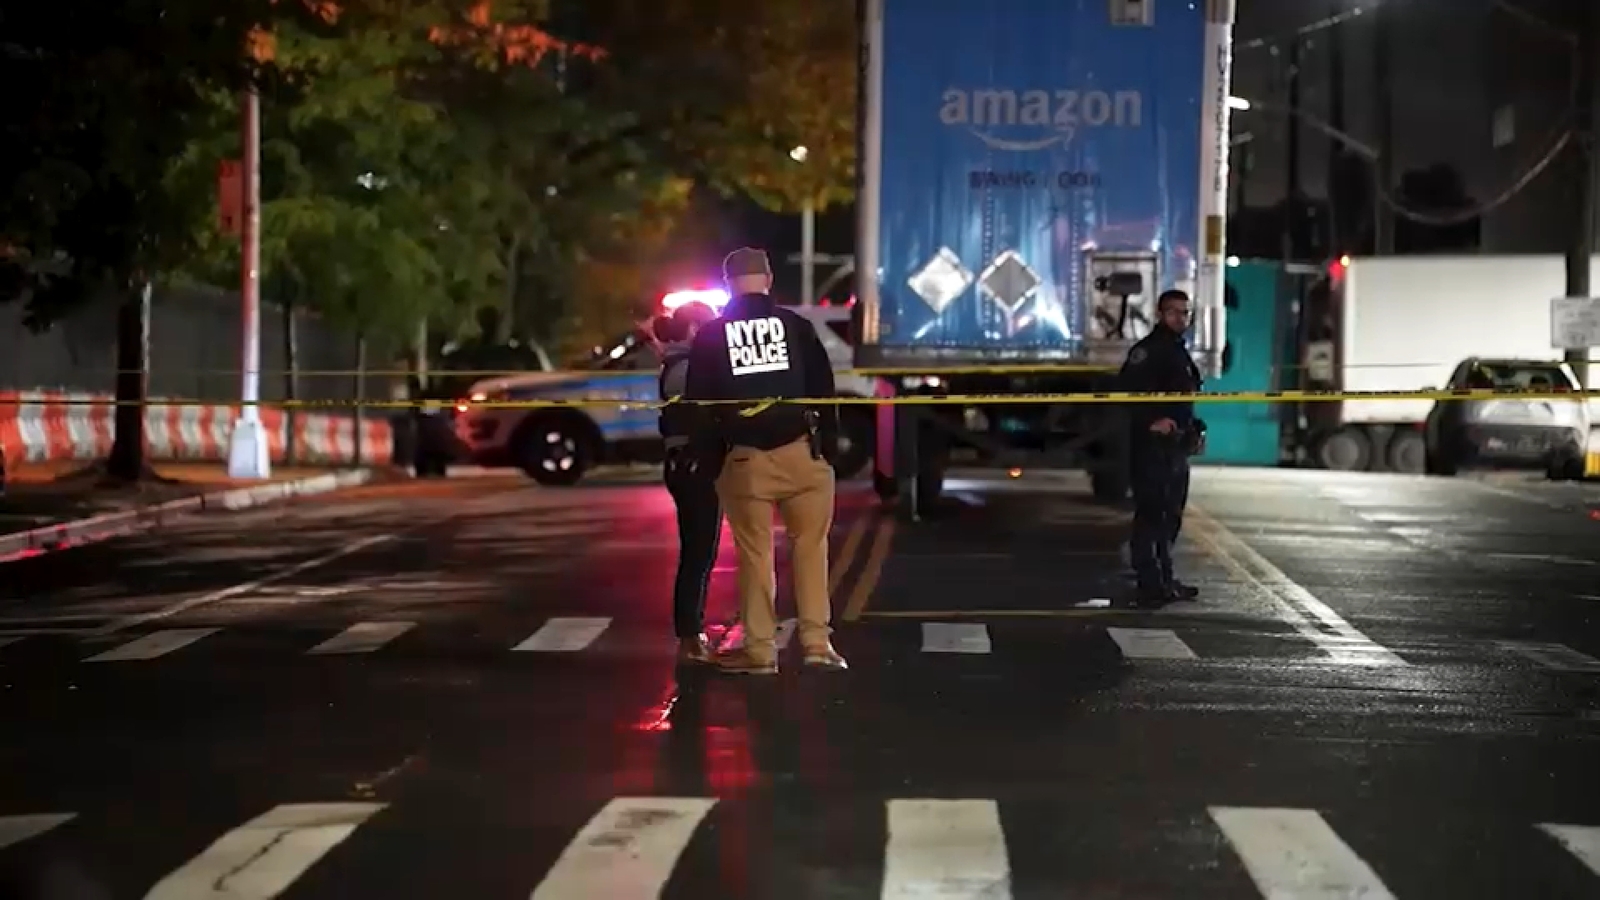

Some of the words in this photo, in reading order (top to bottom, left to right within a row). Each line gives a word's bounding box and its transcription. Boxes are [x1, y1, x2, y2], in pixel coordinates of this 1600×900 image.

[939, 88, 1142, 126] amazon
[725, 317, 785, 347] NYPD
[729, 342, 789, 367] POLICE
